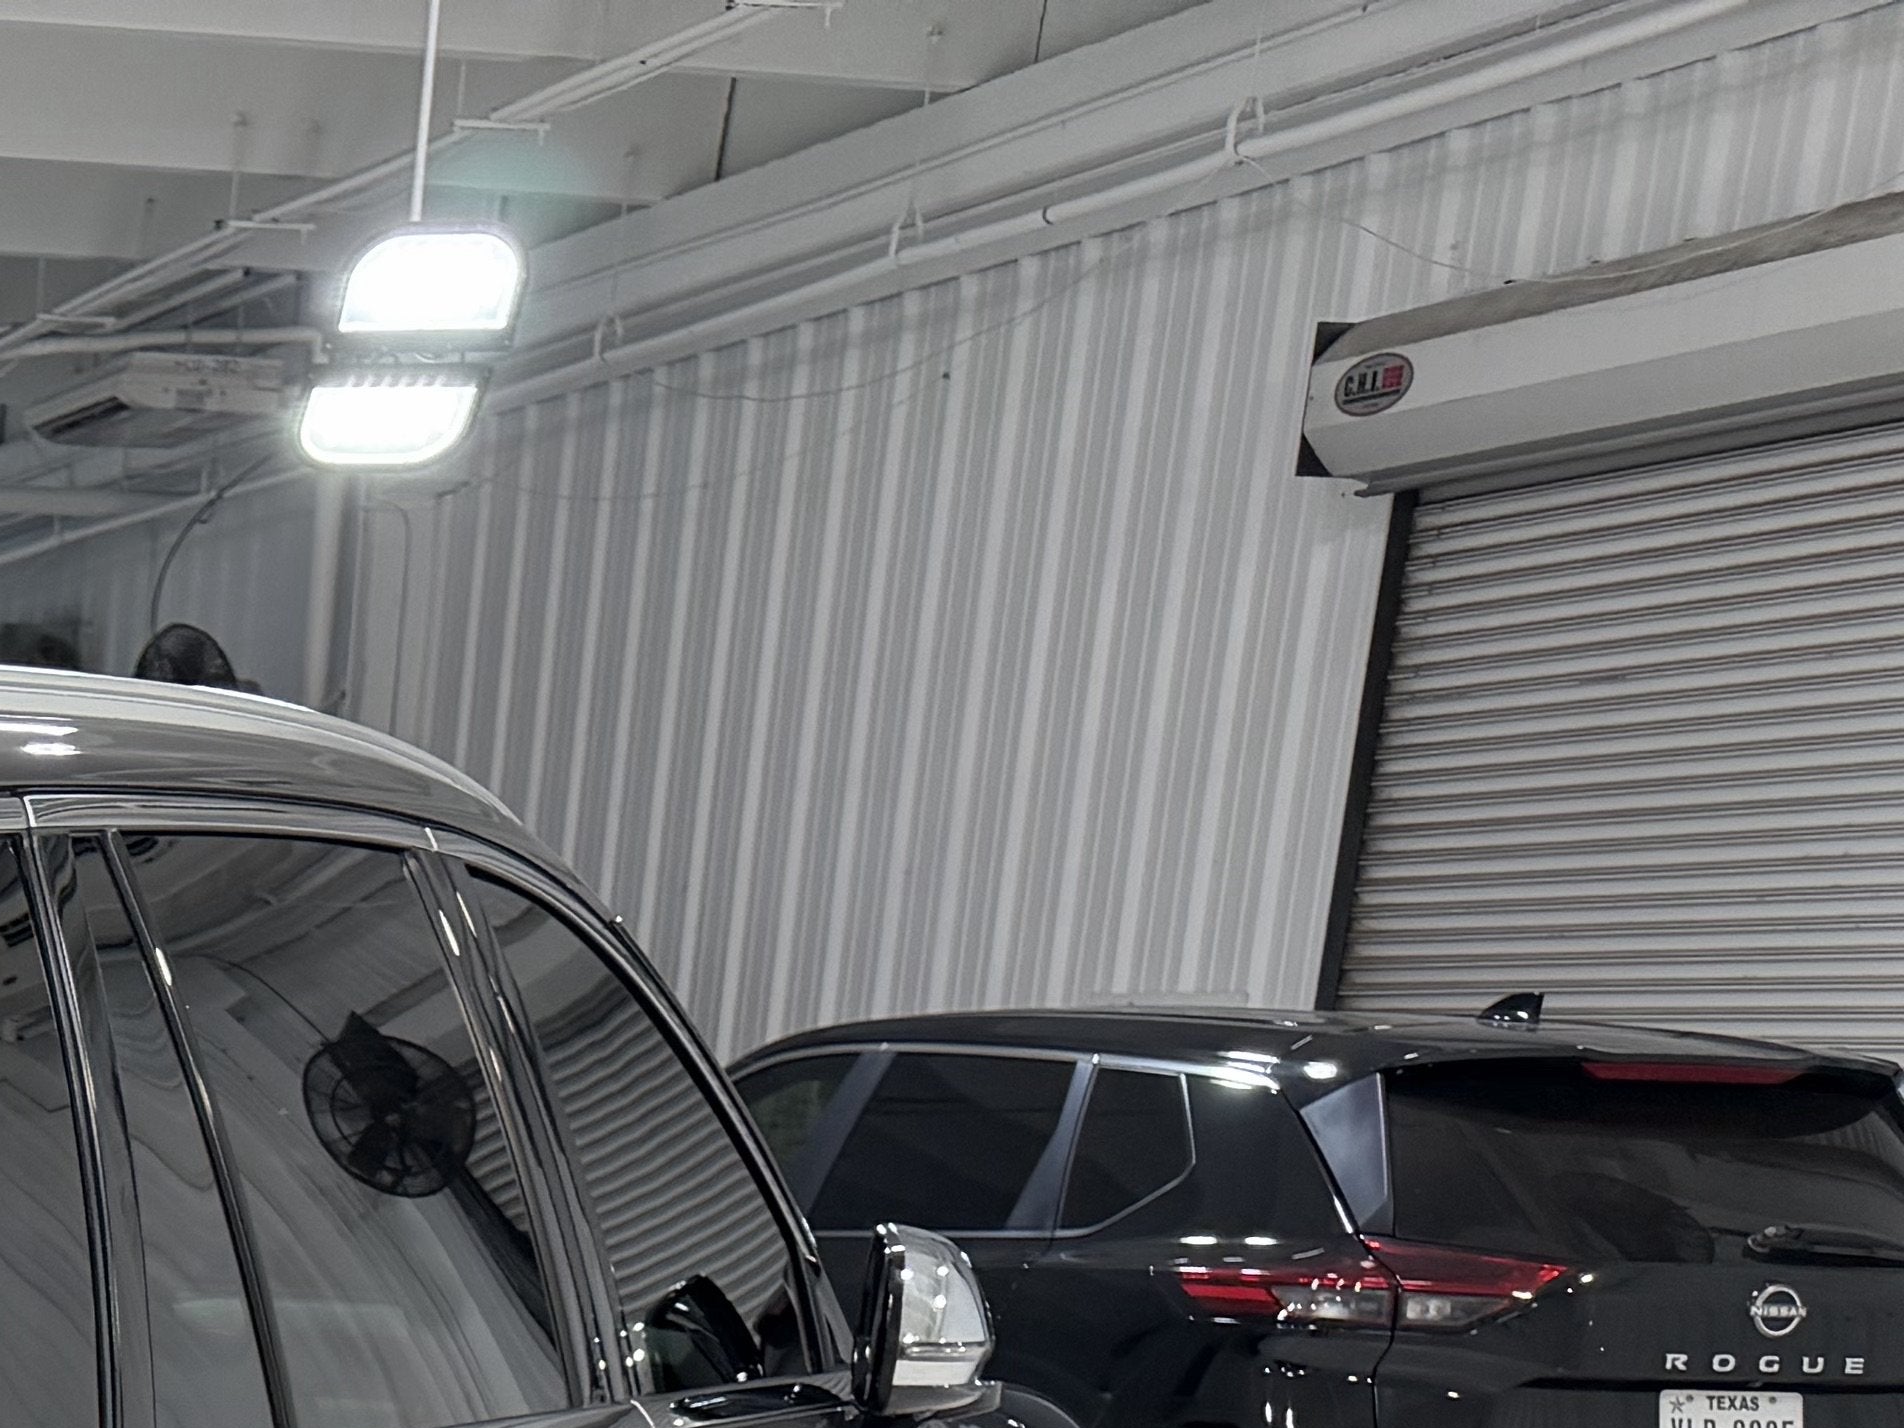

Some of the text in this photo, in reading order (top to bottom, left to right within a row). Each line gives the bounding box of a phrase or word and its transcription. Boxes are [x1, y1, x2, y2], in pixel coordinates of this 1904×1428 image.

[1750, 1303, 1807, 1318] NISSAN
[1665, 1353, 1865, 1374] ROGUE
[1707, 1395, 1760, 1411] TEXAS
